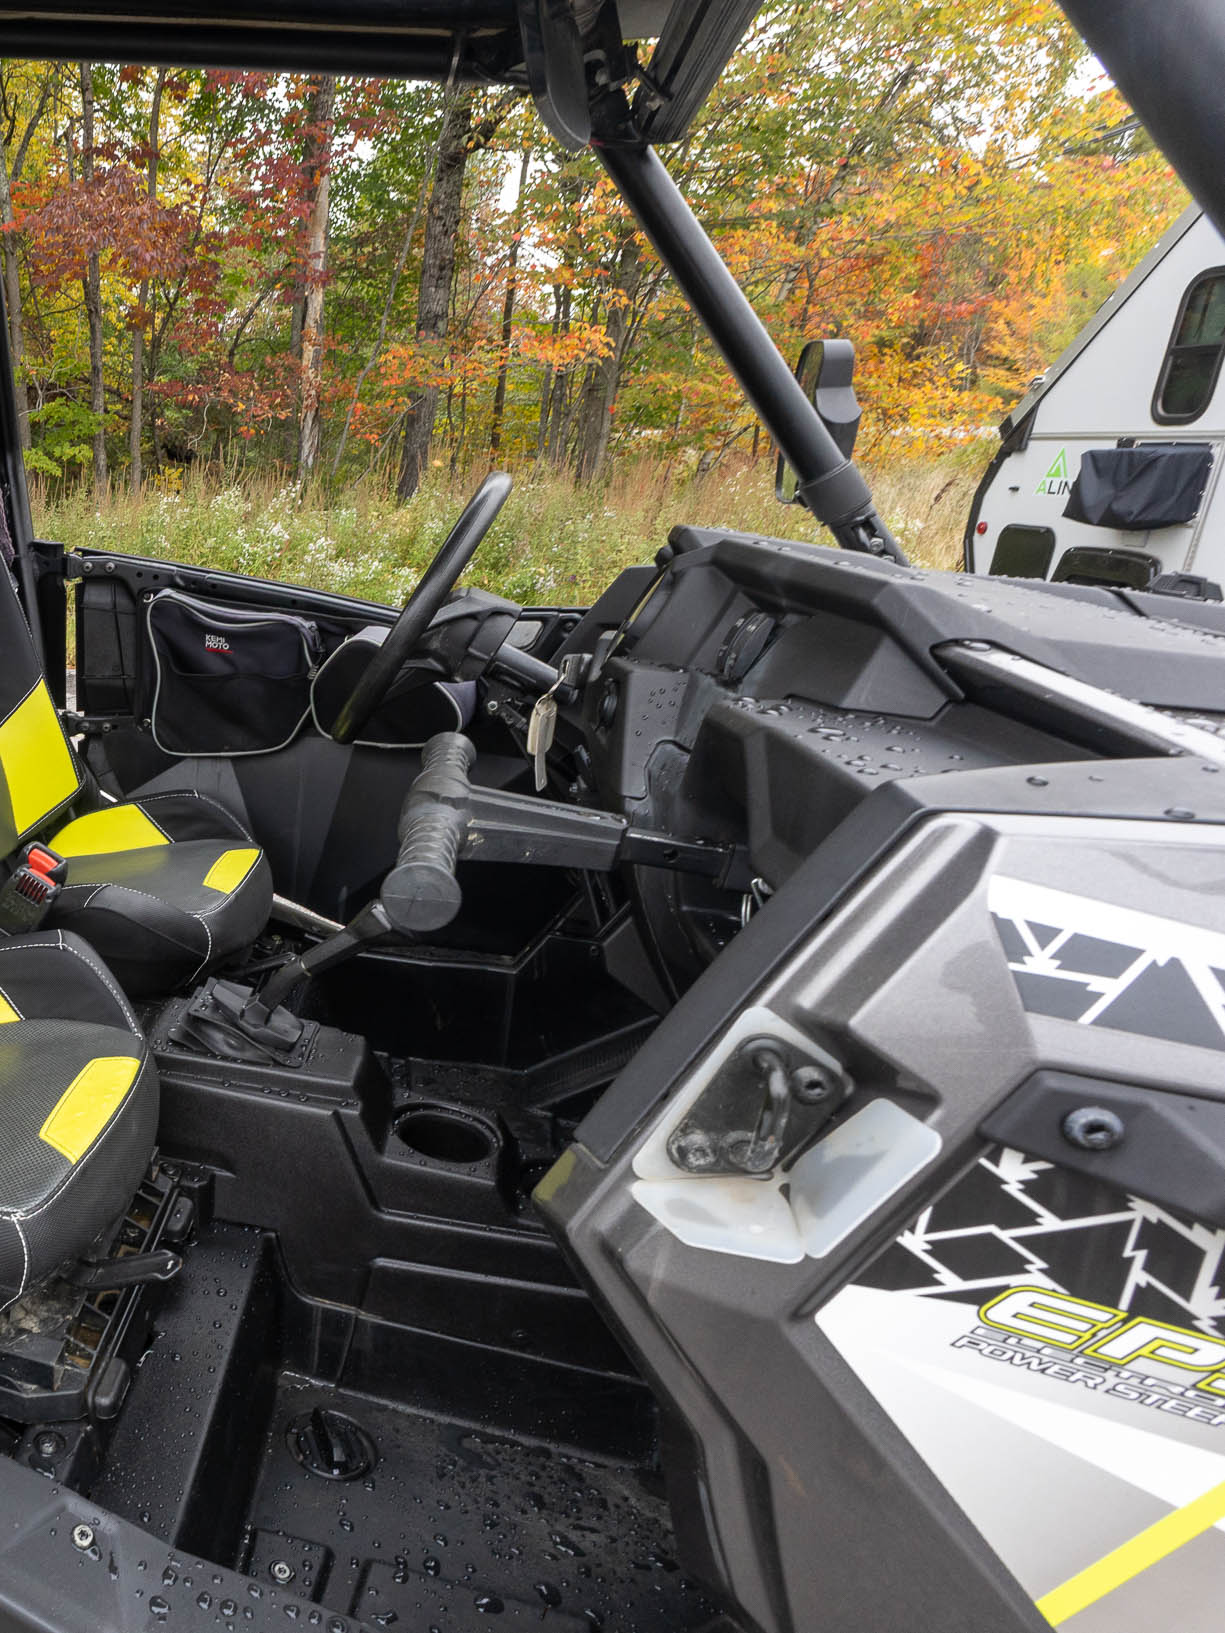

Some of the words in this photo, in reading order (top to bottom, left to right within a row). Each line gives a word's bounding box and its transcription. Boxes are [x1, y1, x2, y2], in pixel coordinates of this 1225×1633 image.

[205, 634, 226, 643] KEMI
[205, 641, 230, 650] MOTO
[977, 1285, 1225, 1398] EP
[951, 1335, 1106, 1390] POWER
